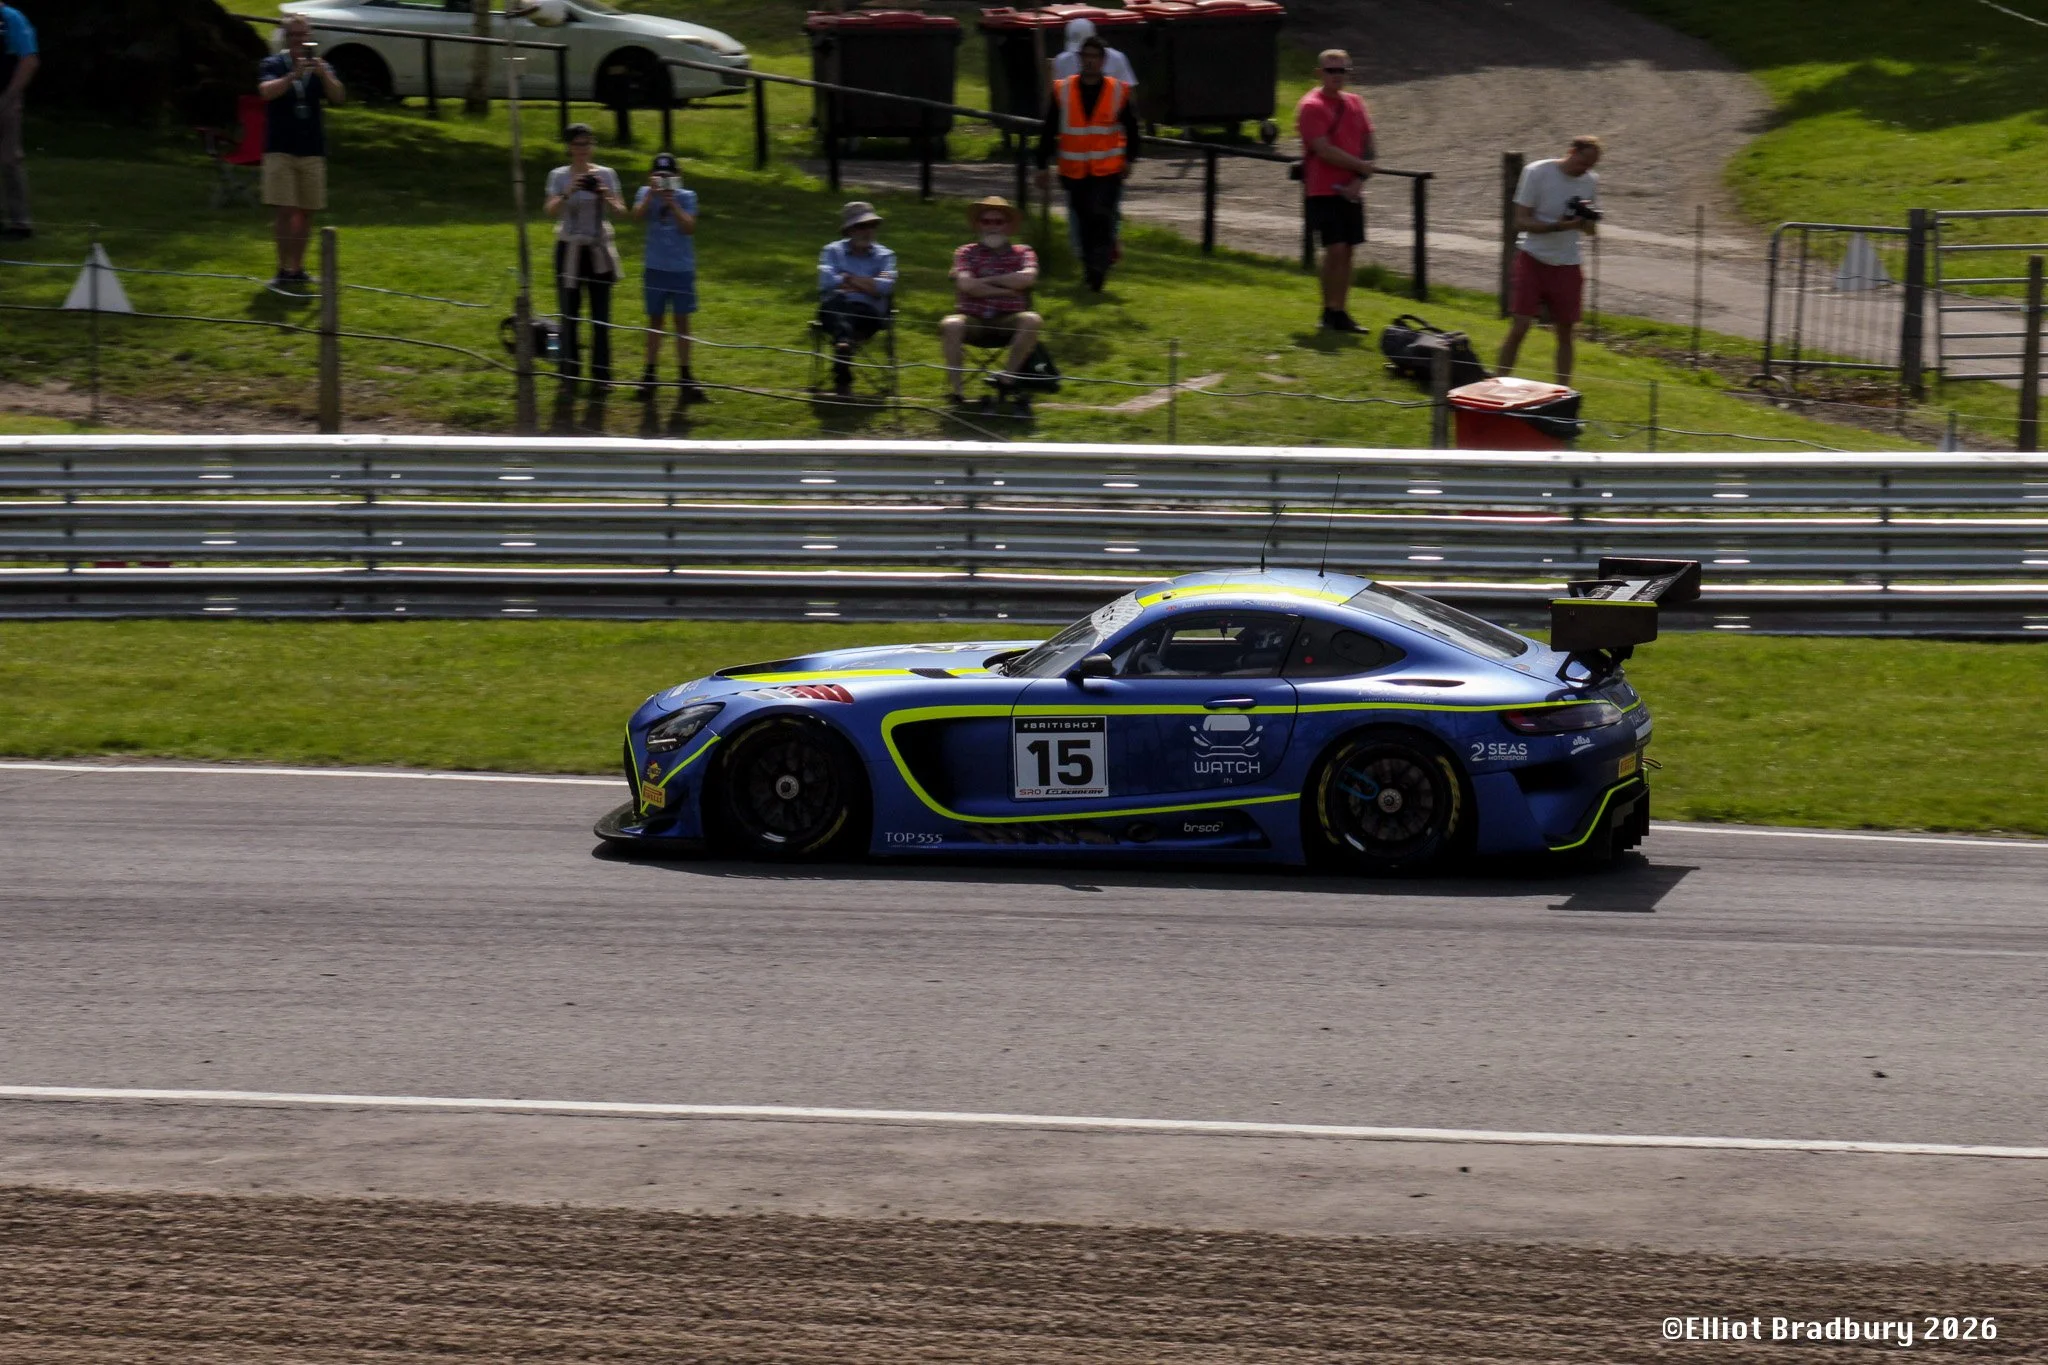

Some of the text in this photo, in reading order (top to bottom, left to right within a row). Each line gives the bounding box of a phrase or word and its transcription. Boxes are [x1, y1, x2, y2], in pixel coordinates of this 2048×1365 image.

[1470, 742, 1528, 761] 2 SEAS
[1026, 739, 1094, 786] 15
[1194, 761, 1260, 774] WATCH
[1019, 788, 1042, 796] SRO
[1184, 821, 1221, 833] brscc
[885, 832, 943, 844] TOP 555
